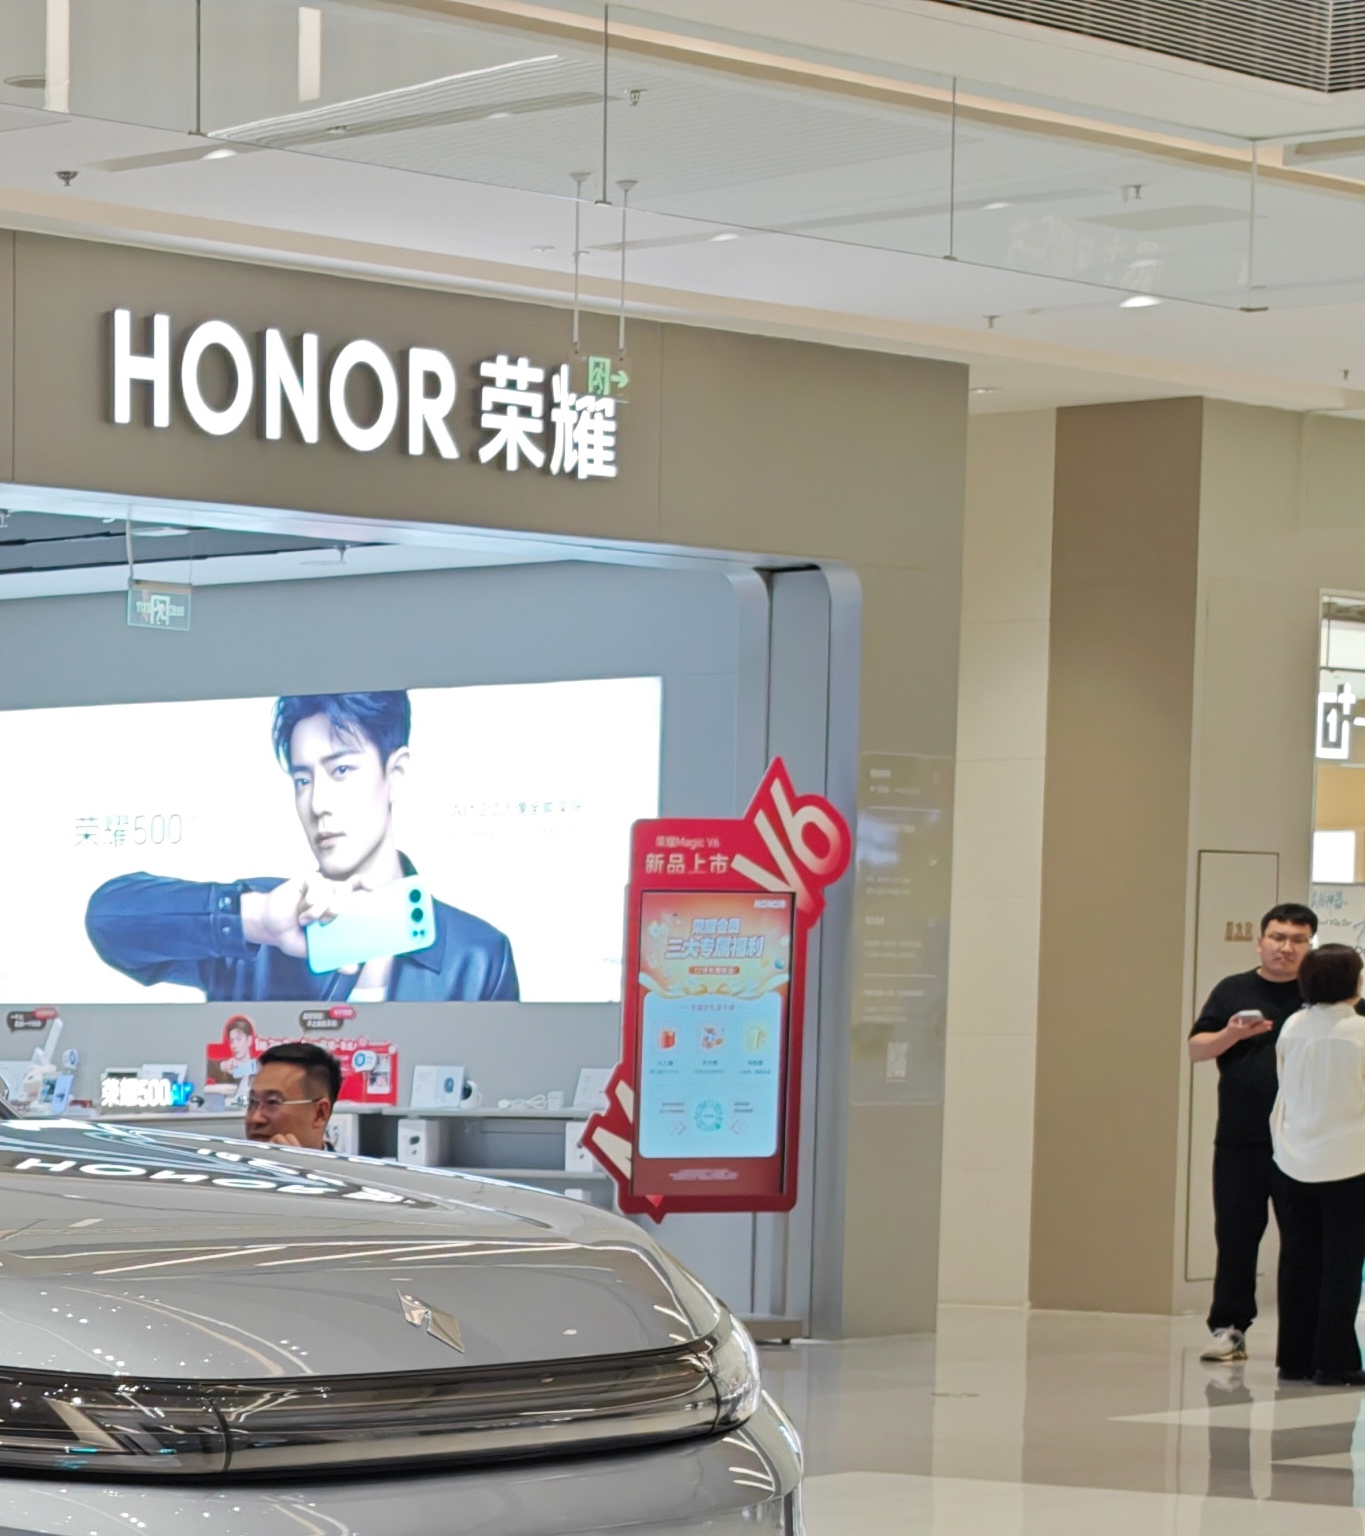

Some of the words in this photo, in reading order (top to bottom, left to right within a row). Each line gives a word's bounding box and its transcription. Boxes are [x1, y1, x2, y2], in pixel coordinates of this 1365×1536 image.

[111, 307, 460, 460] HONOR
[477, 354, 618, 481] 荣耀
[645, 853, 729, 875] 新品上市
